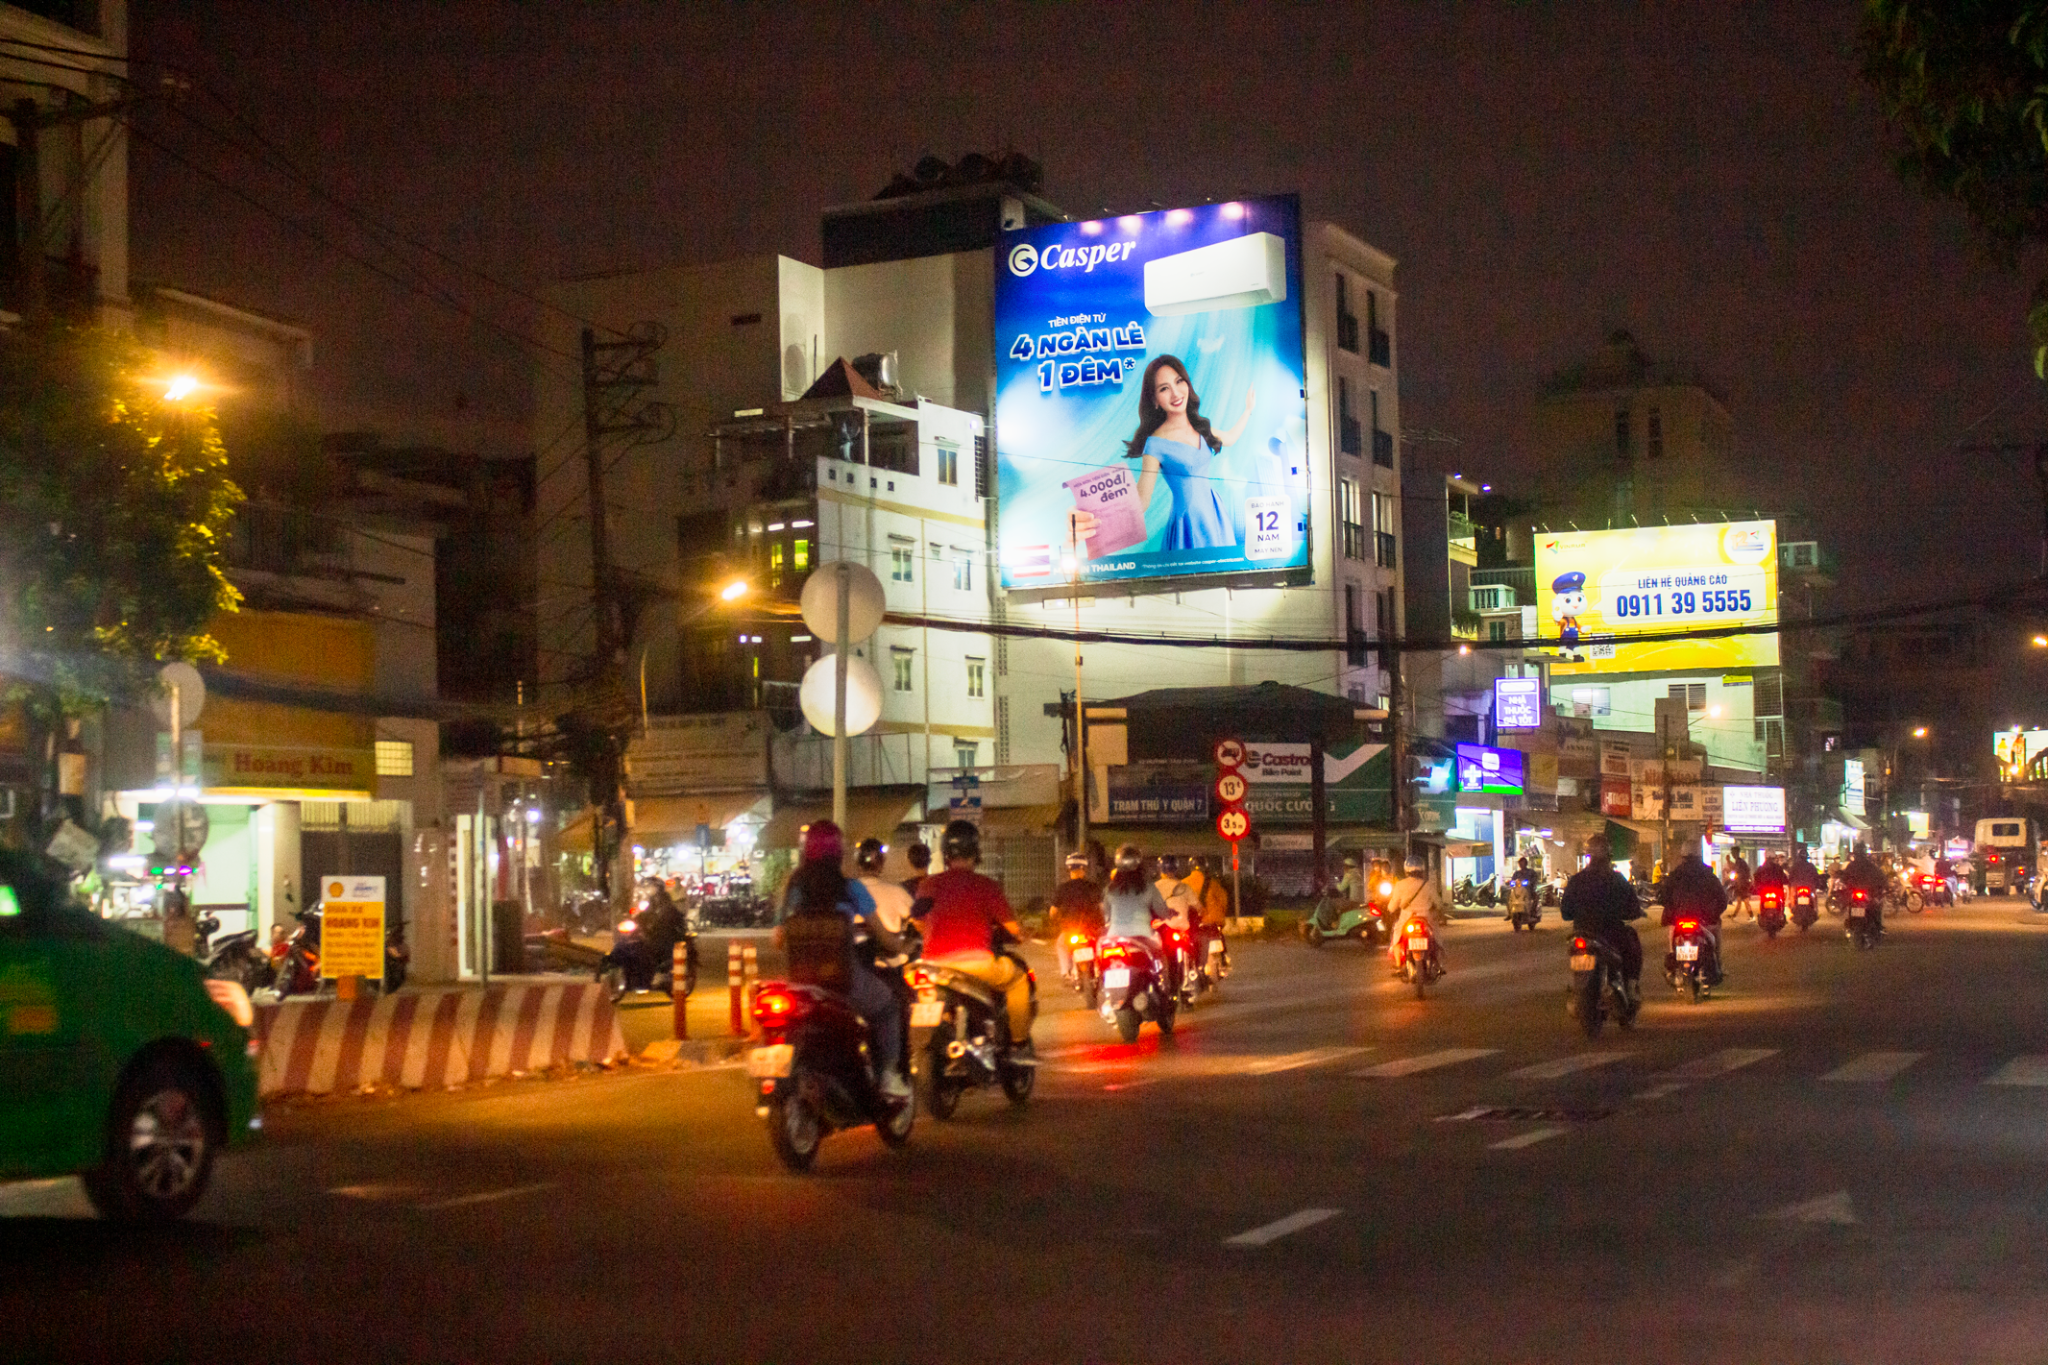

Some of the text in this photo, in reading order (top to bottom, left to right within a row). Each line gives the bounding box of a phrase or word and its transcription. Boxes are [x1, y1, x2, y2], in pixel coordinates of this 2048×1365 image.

[1040, 241, 1136, 273] Casper
[1048, 312, 1107, 328] TIỀN ĐIỆN TỪ
[1010, 321, 1146, 361] 4 NGÀN LẺ
[1038, 360, 1055, 392] 1
[1255, 511, 1279, 532] 12
[1091, 562, 1136, 573] THAILAND
[1638, 572, 1728, 589] LIÊN HỆ QUẢNG CÁO
[1616, 589, 1752, 617] 0911 39 5555
[1281, 768, 1302, 776] Point
[1162, 799, 1169, 811] Y
[1197, 799, 1203, 811] 7
[1245, 798, 1283, 813] QUỐC
[1731, 799, 1748, 812] LIÊN
